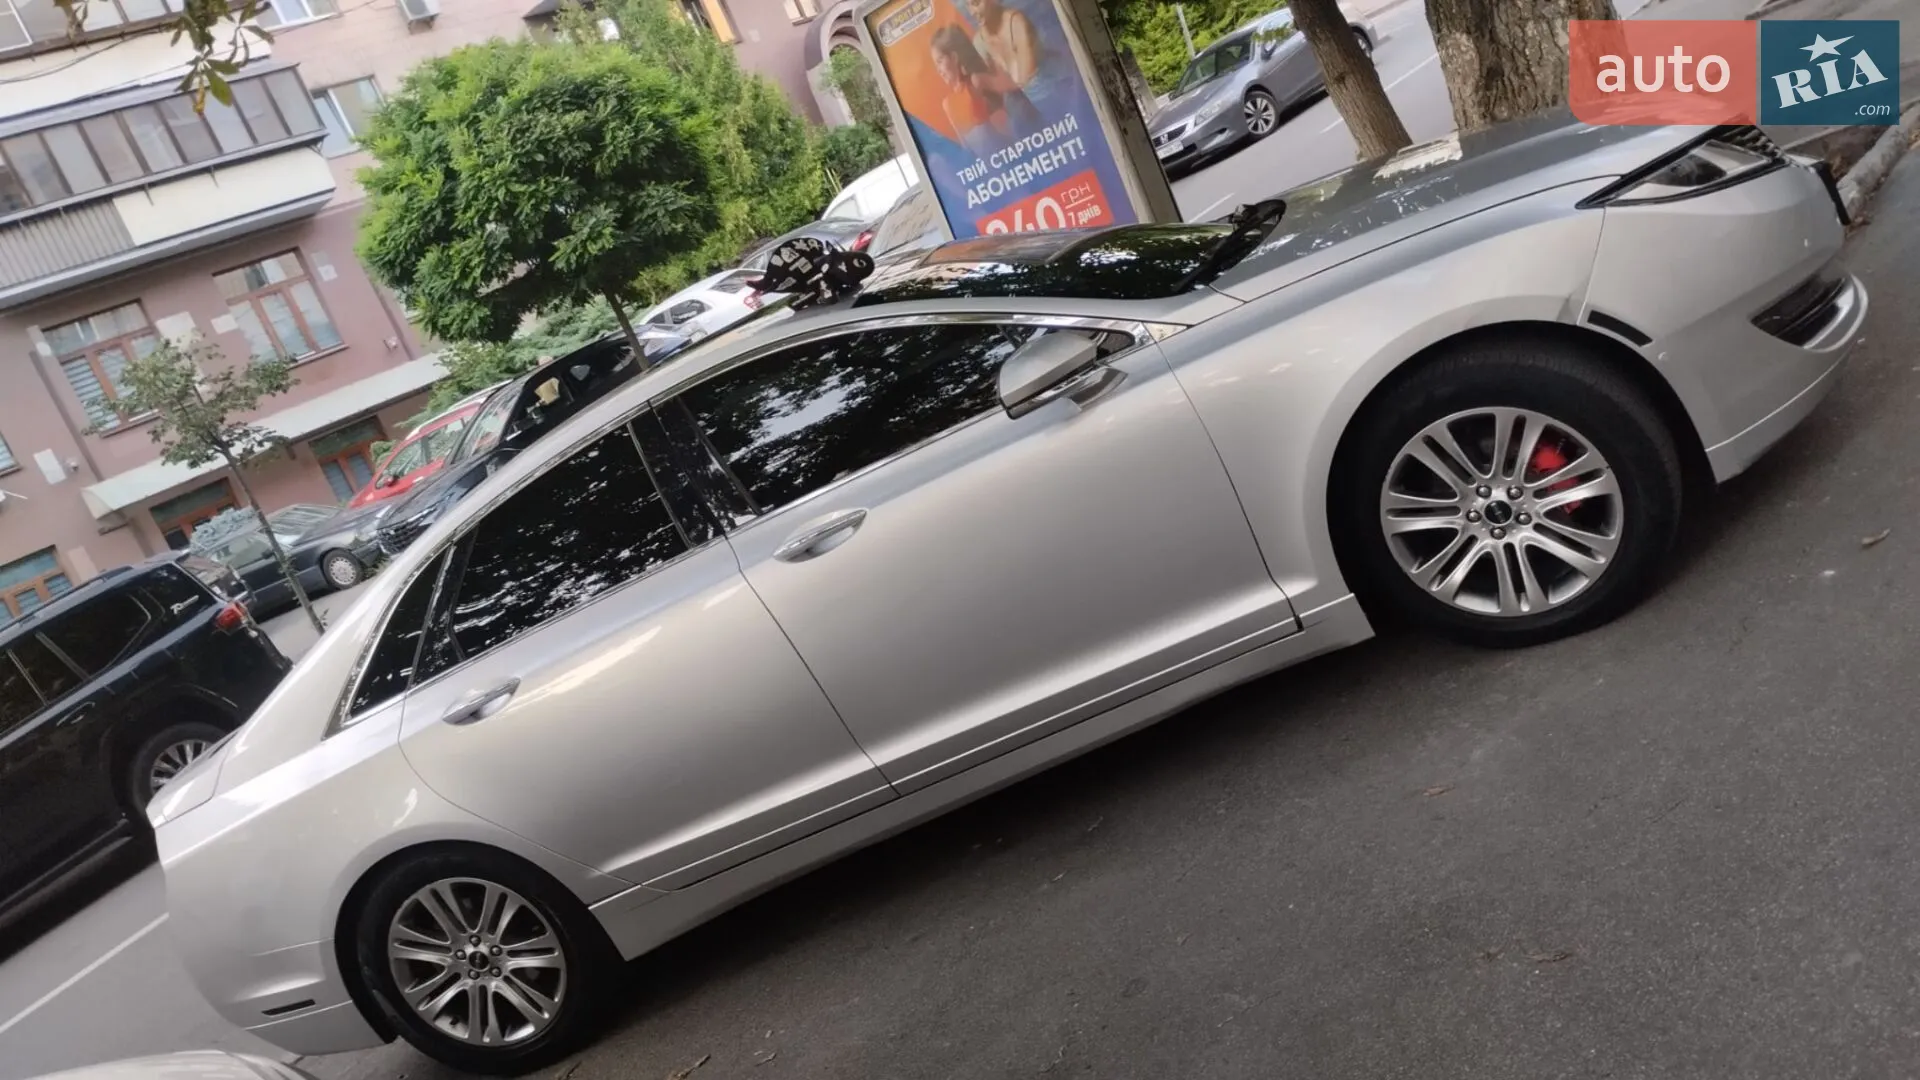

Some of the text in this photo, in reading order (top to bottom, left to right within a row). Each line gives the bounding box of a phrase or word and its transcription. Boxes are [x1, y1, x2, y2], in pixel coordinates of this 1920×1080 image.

[956, 112, 1079, 185] ТВІЙ СТАРТОВИЙ
[967, 136, 1087, 209] АБОНЕМЕНТ!
[1067, 211, 1076, 227] 7
